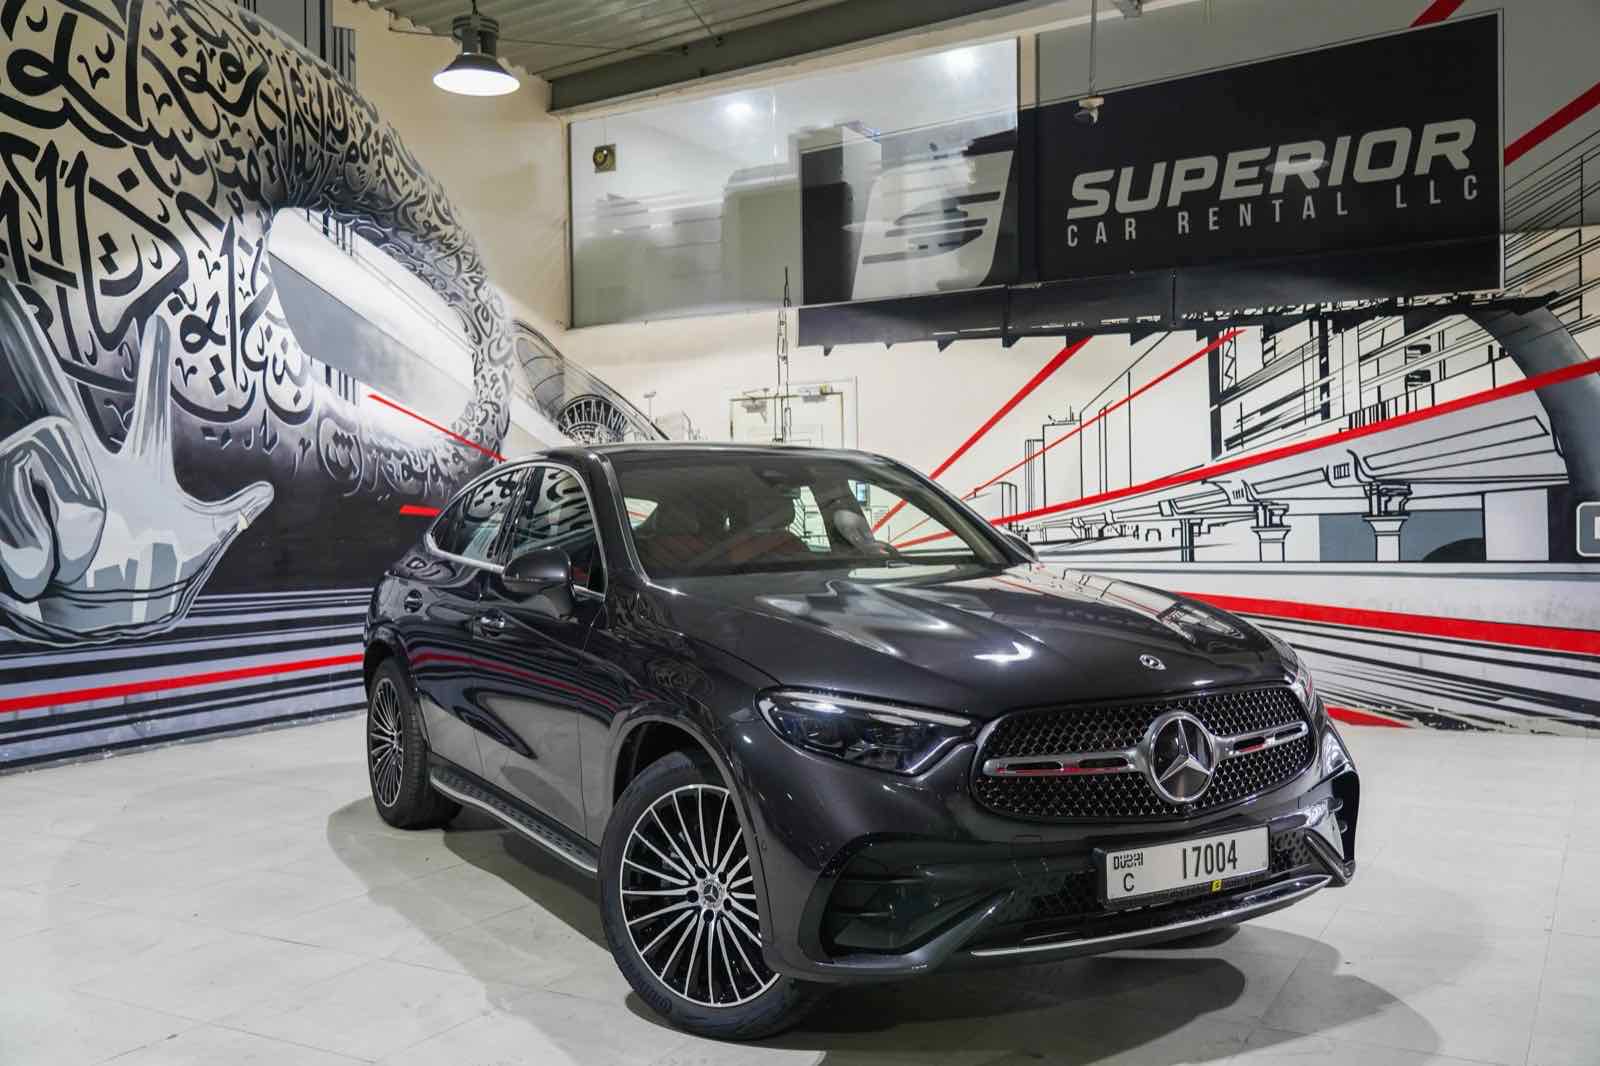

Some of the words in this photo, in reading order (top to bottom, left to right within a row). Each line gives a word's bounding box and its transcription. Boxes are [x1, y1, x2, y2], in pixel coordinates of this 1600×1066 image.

[1067, 118, 1476, 220] SUPERIOR
[1067, 218, 1137, 247] CAR
[1177, 193, 1348, 234] RENTAL
[1395, 175, 1478, 208] LLC
[1113, 851, 1144, 870] DUBAI
[1182, 839, 1238, 880] 17004
[1123, 872, 1135, 892] C
